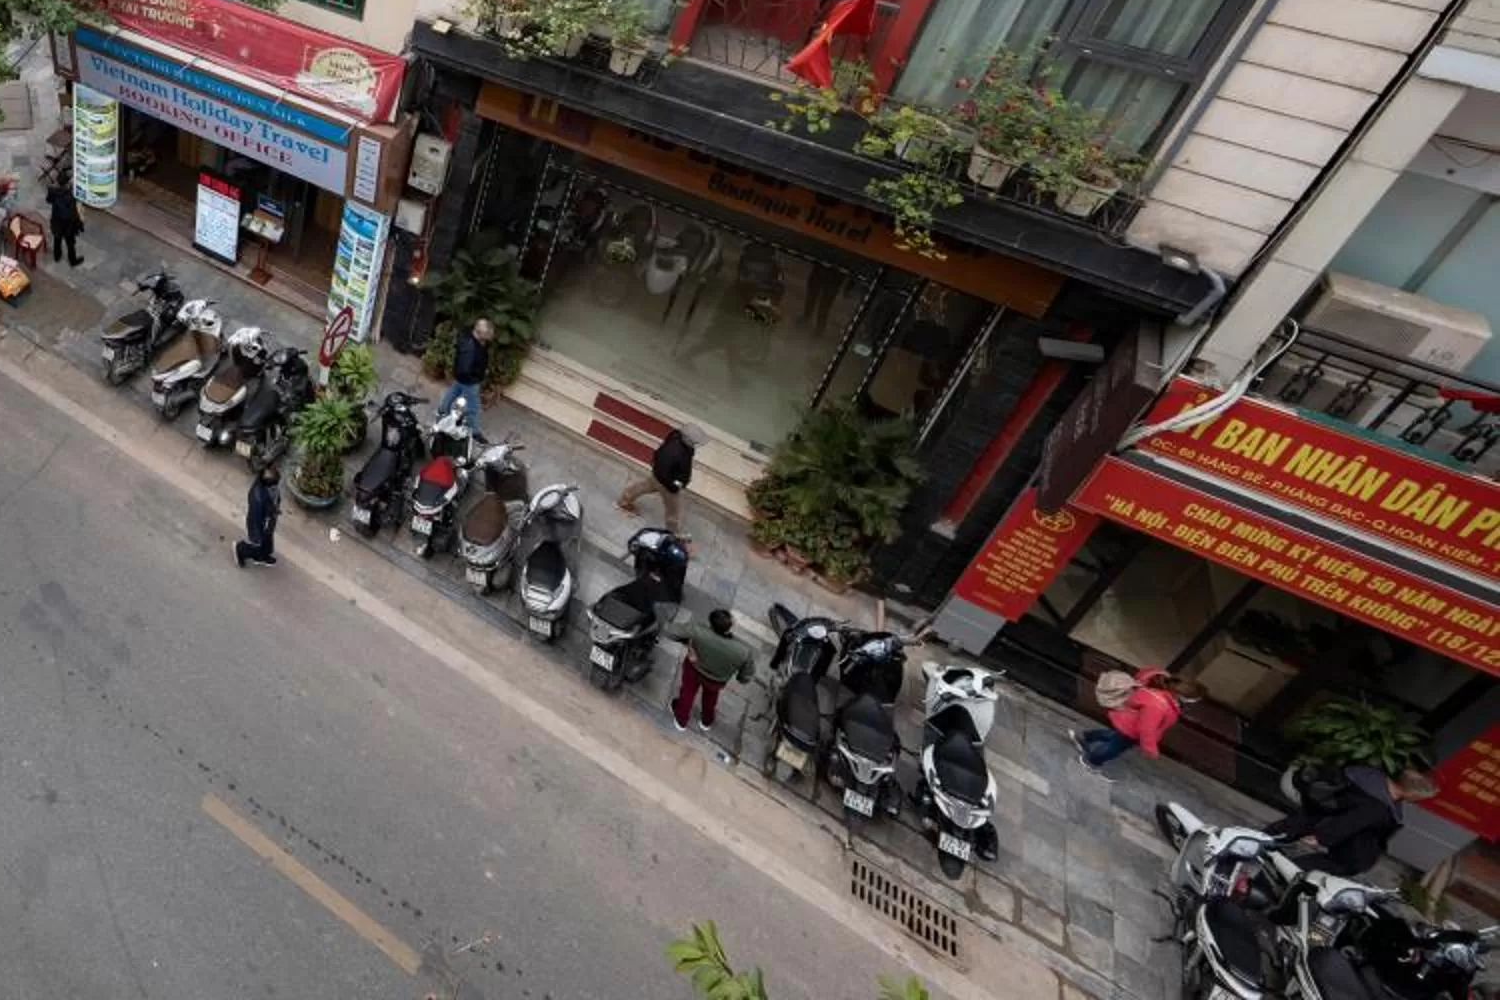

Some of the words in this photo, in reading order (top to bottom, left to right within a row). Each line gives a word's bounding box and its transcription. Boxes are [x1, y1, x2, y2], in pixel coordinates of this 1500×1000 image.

[91, 55, 169, 98] Vietnam
[173, 87, 253, 134] Holiday
[258, 120, 329, 163] Travel
[119, 84, 208, 131] BOOKING
[214, 125, 293, 167] OFFICE
[707, 172, 799, 219] Boutique
[805, 205, 873, 244] Hotel
[1211, 418, 1293, 467] BAN
[1282, 443, 1391, 502] NHÂN
[1380, 483, 1472, 531] DÂN
[1134, 507, 1170, 531] NỘI
[1172, 523, 1218, 550] ĐIỆN
[1214, 540, 1261, 567] BIÊN
[1257, 557, 1303, 583] PHỦ
[1299, 573, 1350, 603] TRÊN
[1183, 503, 1233, 530] CHÀO
[1230, 521, 1289, 553] MỪNG
[1312, 555, 1369, 586] NIỆM
[1366, 575, 1397, 595] 50
[1394, 586, 1448, 615] NĂM
